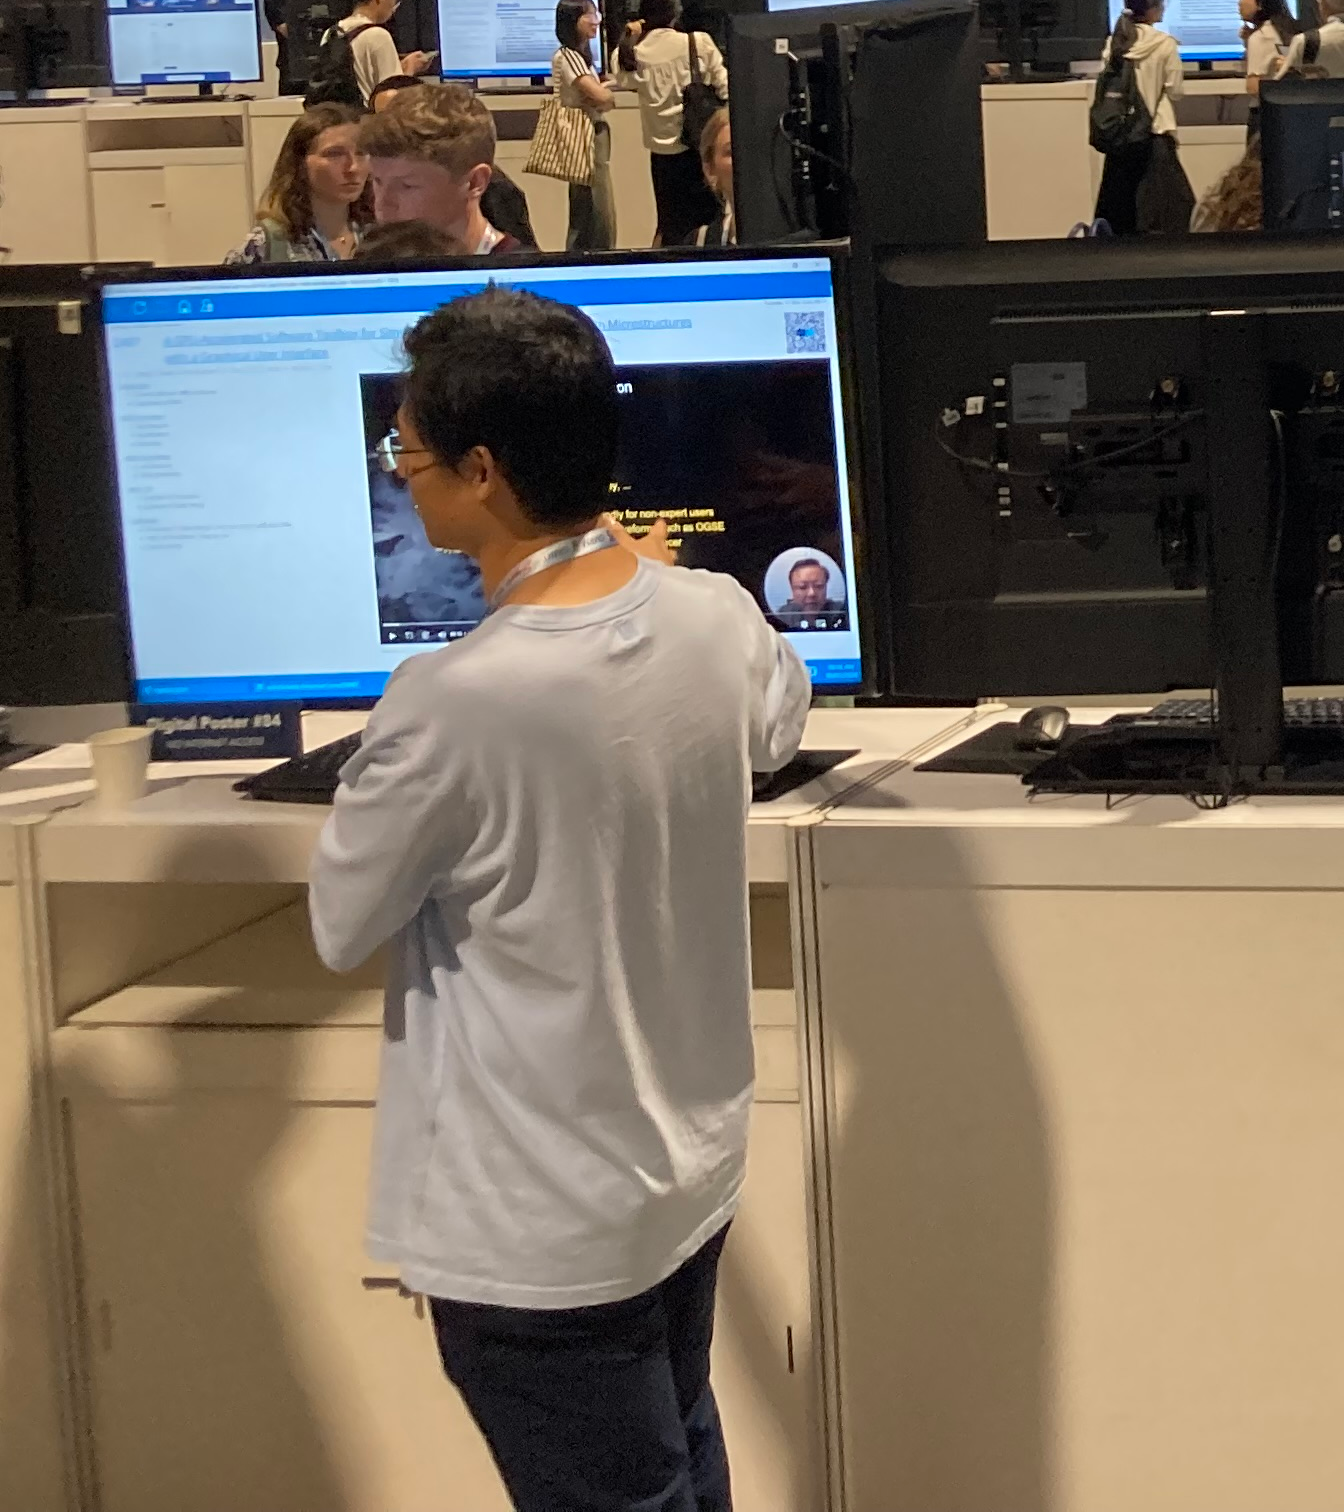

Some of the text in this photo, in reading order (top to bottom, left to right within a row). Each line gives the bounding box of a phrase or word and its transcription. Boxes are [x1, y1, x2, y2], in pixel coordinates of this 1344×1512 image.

[616, 382, 633, 393] on
[625, 508, 714, 519] for non-expert users
[695, 521, 726, 532] OGSE
